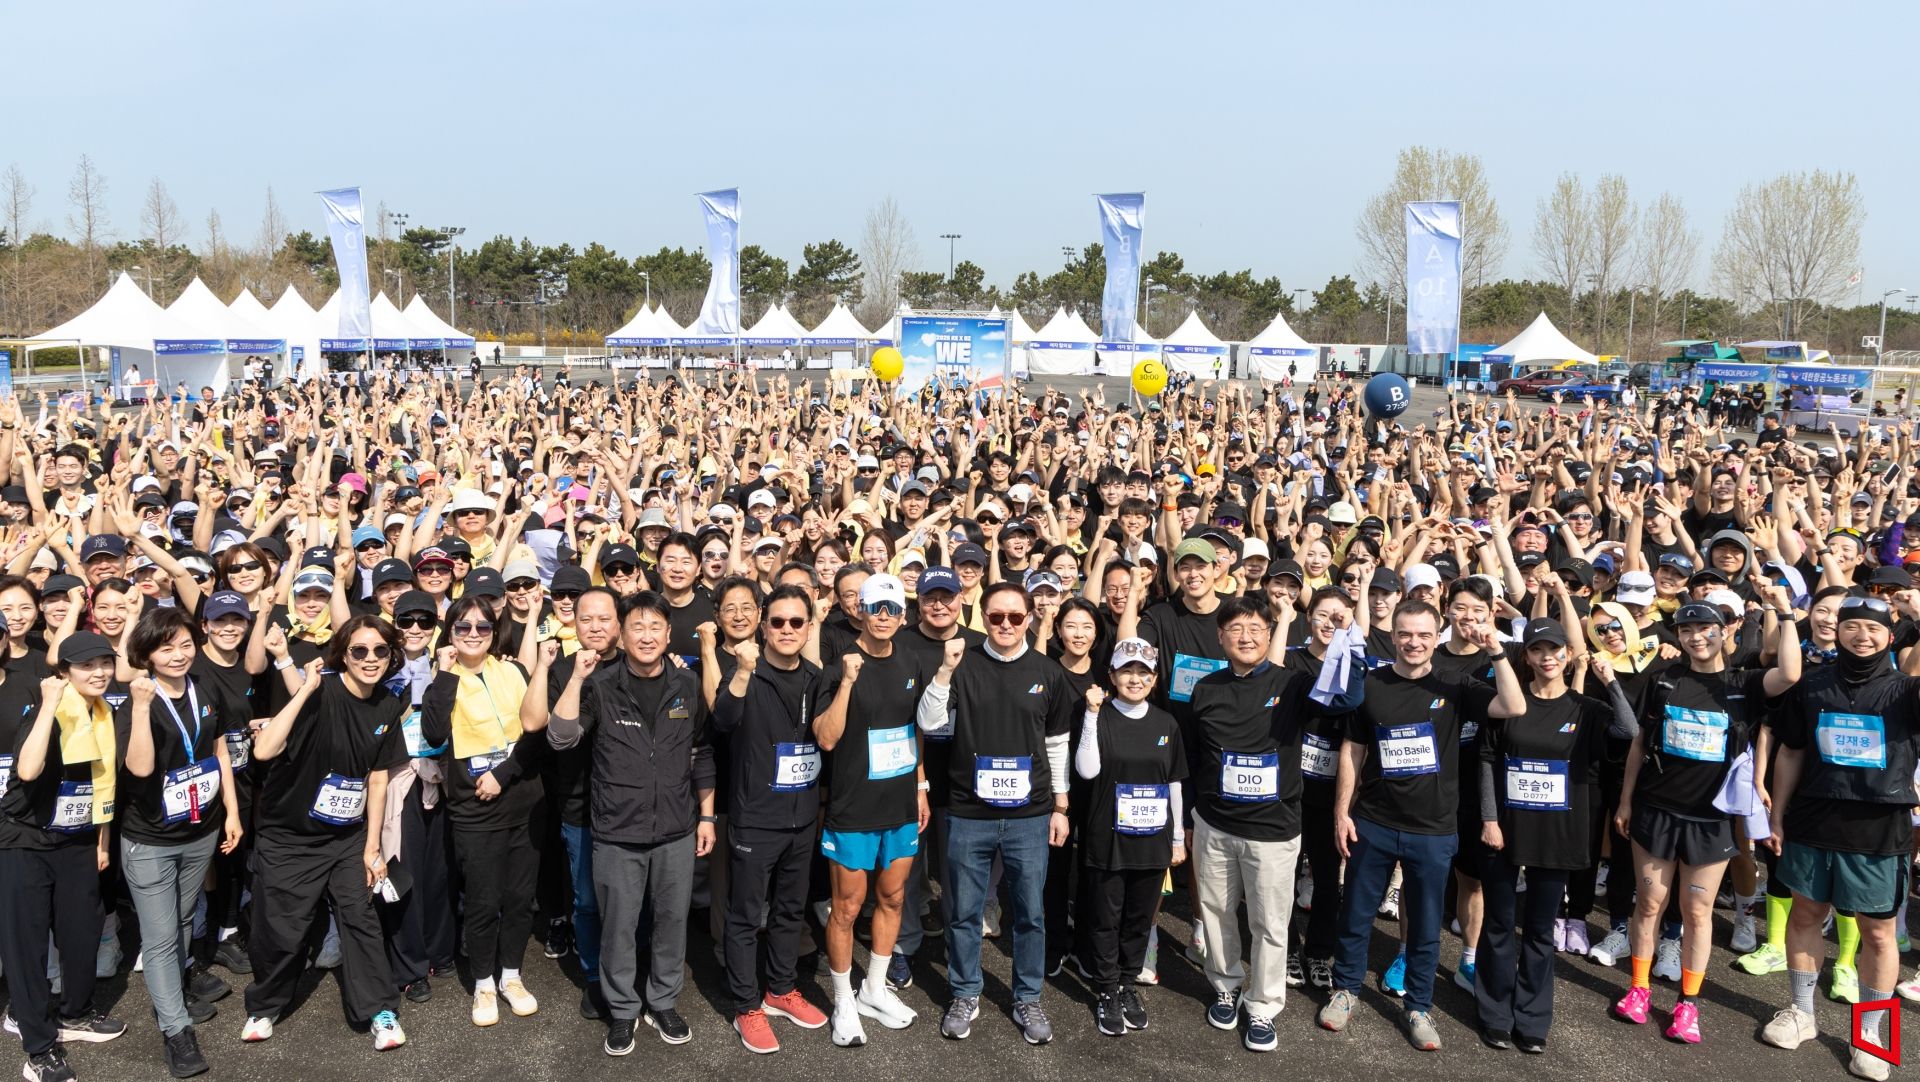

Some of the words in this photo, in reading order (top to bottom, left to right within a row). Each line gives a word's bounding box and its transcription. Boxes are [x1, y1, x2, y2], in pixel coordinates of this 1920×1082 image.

[936, 341, 972, 363] WE
[1143, 364, 1153, 373] C
[1391, 386, 1404, 402] B
[1386, 400, 1409, 411] 27:30
[925, 571, 952, 583] SRIXON
[1834, 734, 1871, 747] 김재용
[1383, 747, 1403, 757] Tino
[1404, 745, 1431, 755] Basile
[791, 761, 815, 774] COZ
[992, 778, 1018, 788] BKE
[1237, 774, 1262, 785] DIO
[1517, 779, 1555, 792] 문슬아
[176, 780, 210, 800] 이정
[1131, 805, 1158, 816] 길연주
